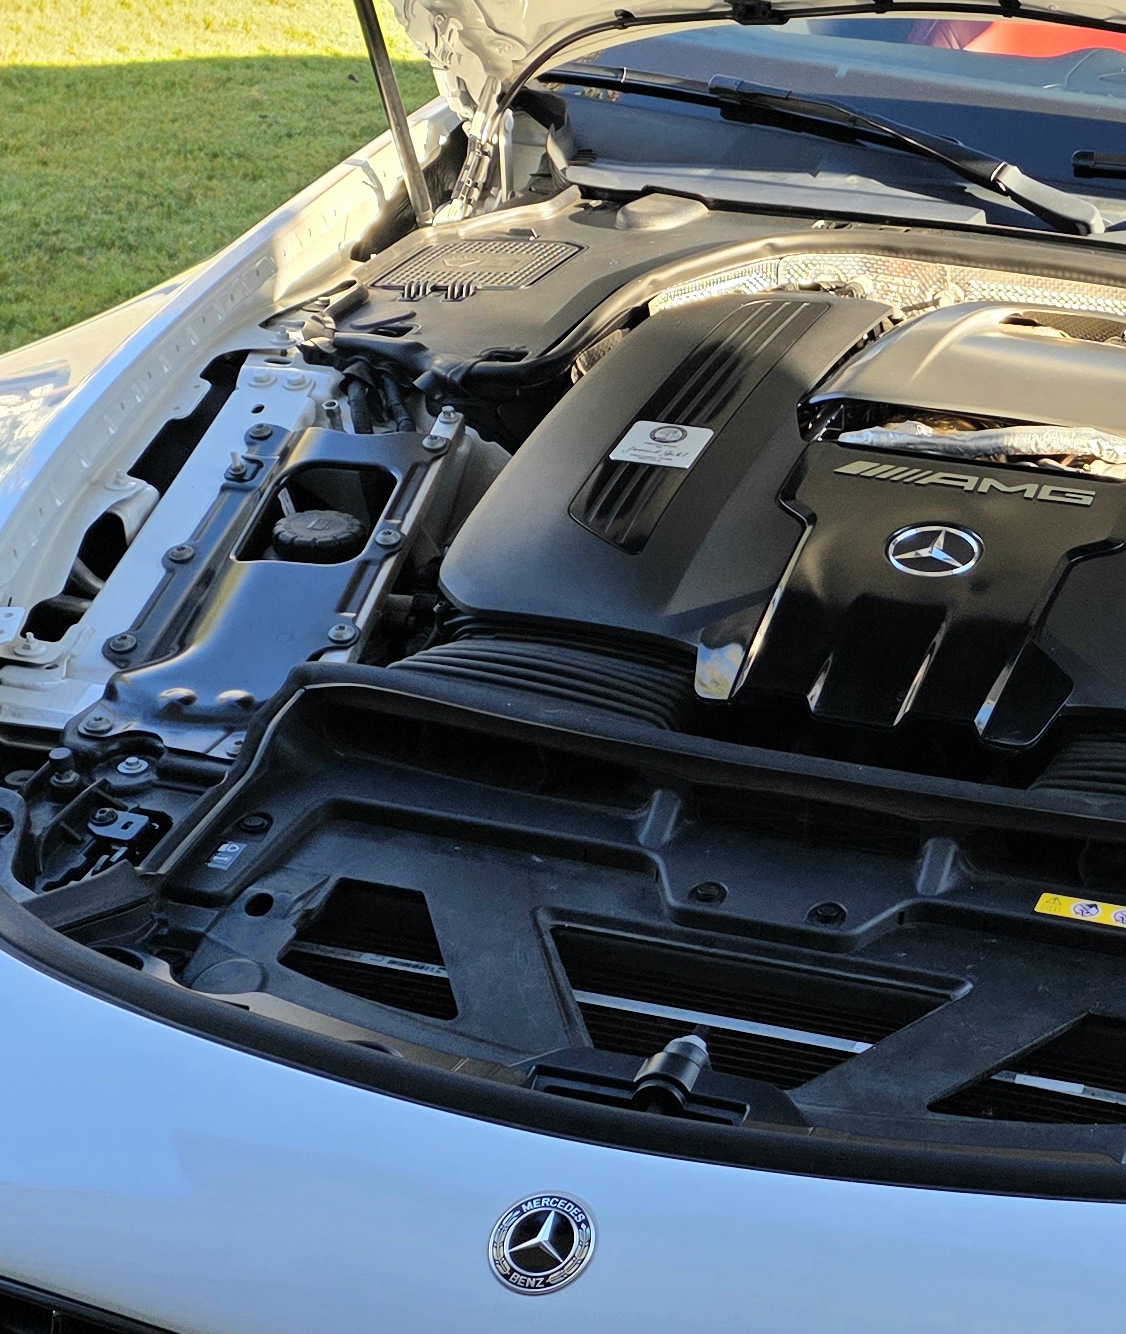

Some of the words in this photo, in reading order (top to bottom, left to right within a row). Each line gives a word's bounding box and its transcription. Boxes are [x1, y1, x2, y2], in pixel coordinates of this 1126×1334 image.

[917, 472, 1096, 506] AMG
[522, 1197, 586, 1223] MERCEDES
[508, 1273, 545, 1288] BENZ
